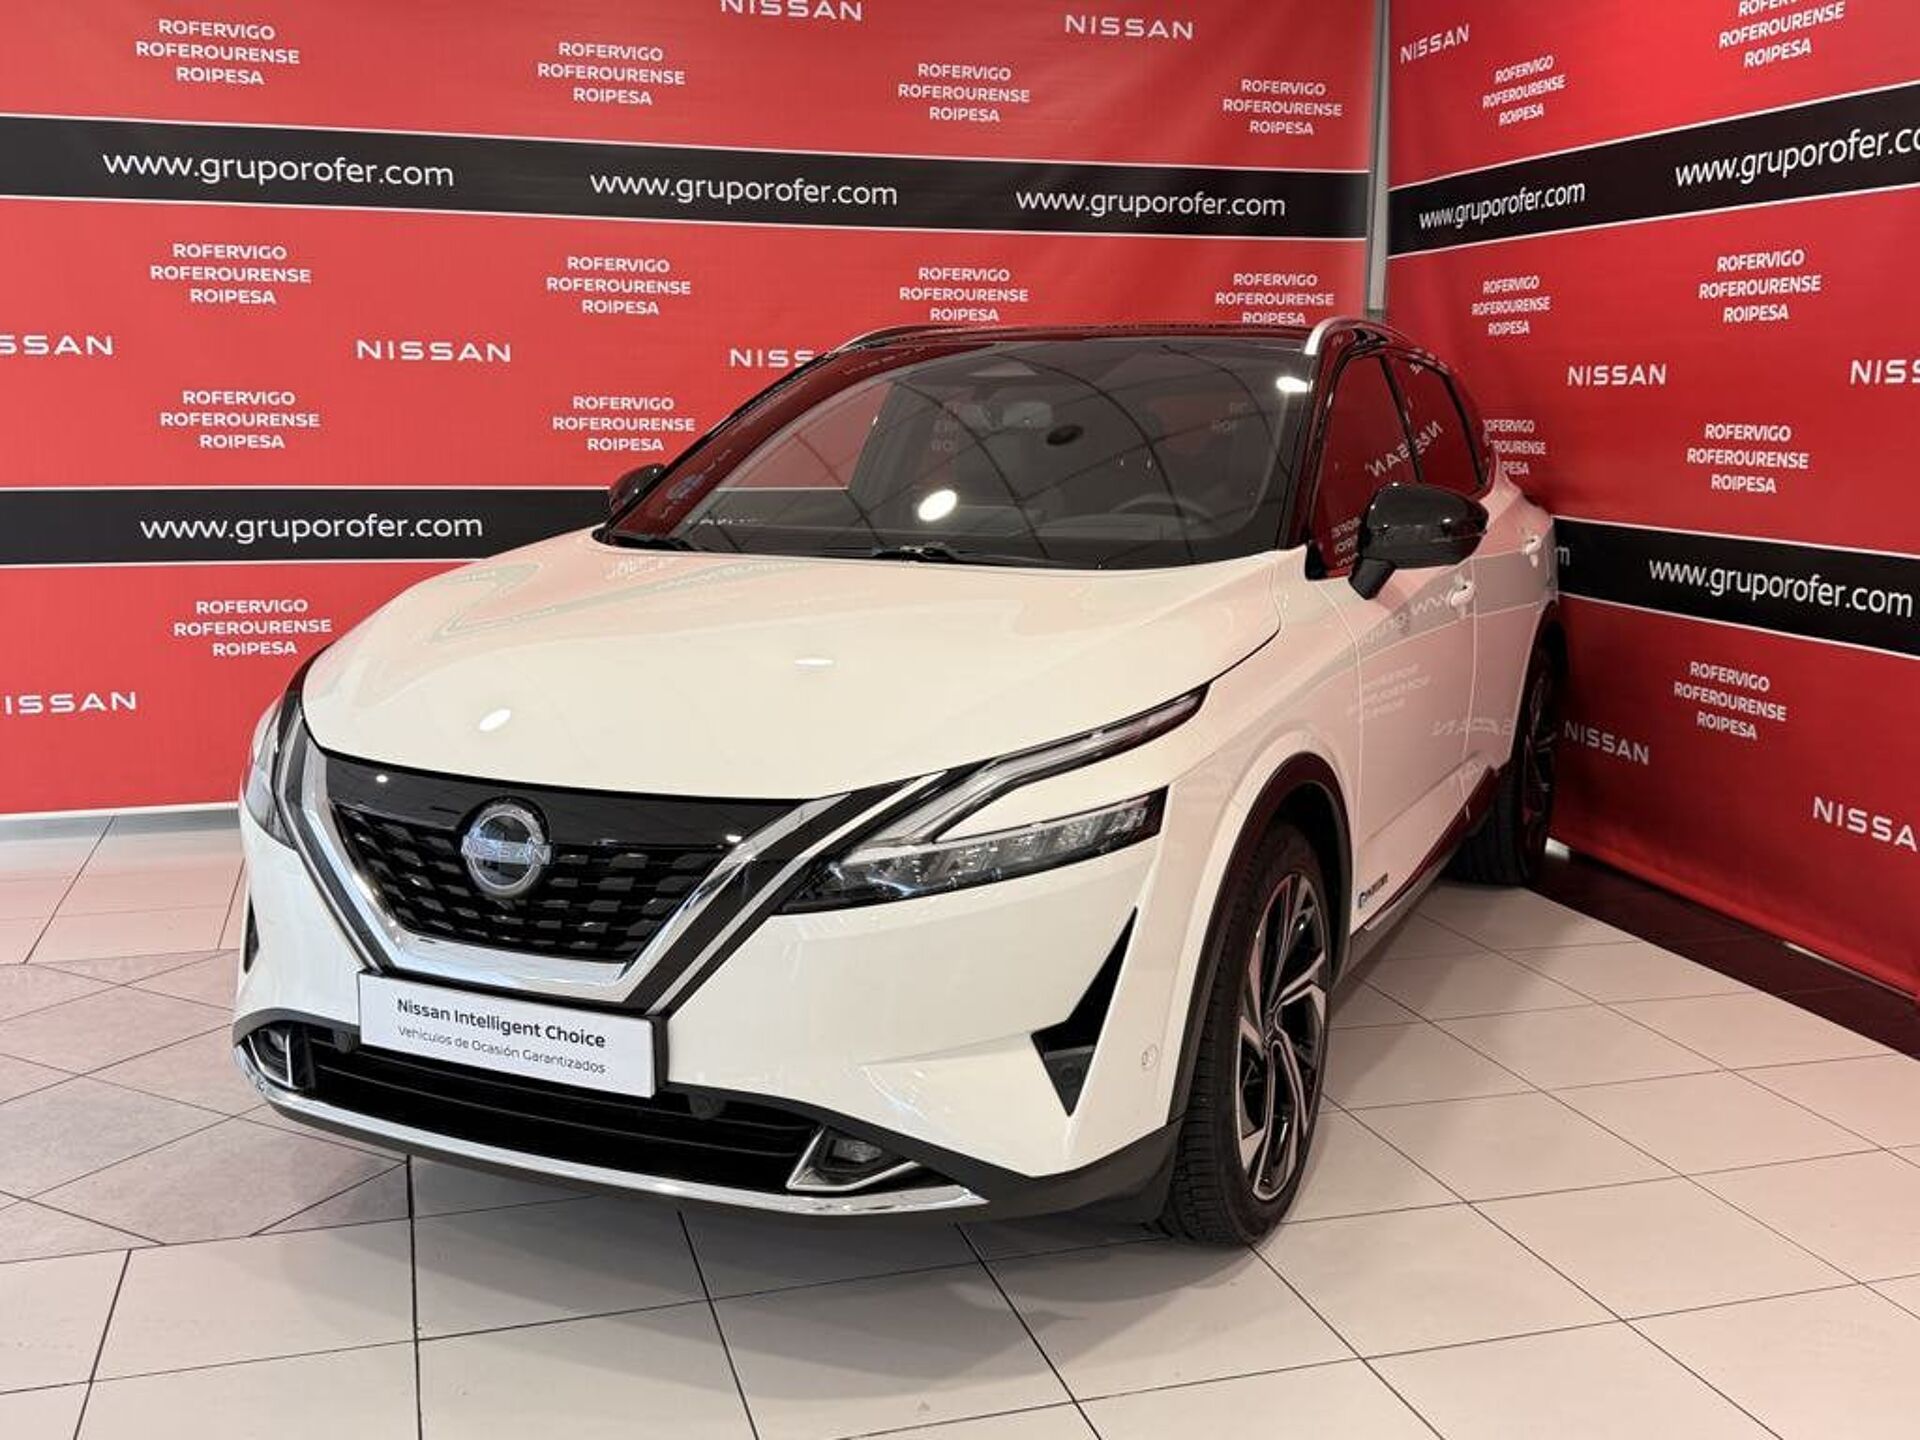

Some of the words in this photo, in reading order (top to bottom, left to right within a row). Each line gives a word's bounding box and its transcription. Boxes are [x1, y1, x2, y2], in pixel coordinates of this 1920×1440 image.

[720, 0, 862, 21] NISSAN
[158, 18, 276, 40] ROFERVIGO
[1065, 14, 1193, 40] NISSAN
[1718, 2, 1846, 49] ROFEROURENSE
[135, 40, 300, 65] ROFEROURENSE
[558, 42, 664, 62] ROFERVIGO
[1400, 24, 1470, 64] NISSAN
[1743, 37, 1812, 68] ROIPESA
[176, 66, 265, 85] ROIPESA
[537, 62, 685, 85] ROFEROURENSE
[918, 62, 1012, 82] ROFERVIGO
[1495, 55, 1553, 85] ROFERVIGO
[573, 87, 653, 106] ROIPESA
[898, 83, 1030, 103] ROFEROURENSE
[1240, 78, 1326, 96] ROFERVIGO
[1482, 75, 1565, 110] ROFEROURENSE
[929, 106, 1001, 123] ROIPESA
[1222, 98, 1343, 117] ROFEROURENSE
[1498, 102, 1544, 126] ROIPESA
[1249, 119, 1314, 136] ROIPESA
[1675, 127, 1920, 187] www.gruporofer.c
[102, 154, 454, 187] www.gruporofer.com
[589, 174, 897, 206] www.gruporofer.com
[1015, 191, 1286, 218] www.gruporofer.com
[1419, 182, 1586, 229] www.gruporofer.com
[172, 243, 288, 260] ROFERVIGO
[1716, 248, 1805, 273] ROFERVIGO
[150, 265, 311, 283] ROFEROURENSE
[567, 255, 670, 273] ROFERVIGO
[918, 267, 1011, 282] ROFERVIGO
[1233, 272, 1318, 287] ROFERVIGO
[1482, 274, 1540, 294] ROFERVIGO
[546, 276, 691, 295] ROFEROURENSE
[899, 286, 1029, 303] ROFEROURENSE
[1698, 274, 1822, 299] ROFEROURENSE
[190, 288, 277, 305] ROIPESA
[1215, 291, 1335, 306] ROFEROURENSE
[1471, 295, 1551, 316] ROFEROURENSE
[581, 299, 660, 315] ROIPESA
[929, 307, 1000, 322] ROIPESA
[1723, 303, 1789, 323] ROIPESA
[1241, 311, 1306, 327] ROIPESA
[1487, 319, 1530, 336] ROIPESA
[0, 334, 113, 356] SSAN
[356, 339, 511, 363] NISSAN
[729, 348, 815, 368] NISS
[1567, 363, 1666, 386] NISSAN
[182, 390, 296, 406] ROFERVIGO
[572, 395, 675, 411] ROFERVIGO
[160, 412, 320, 428] ROFEROURENSE
[552, 416, 695, 432] ROFEROURENSE
[199, 434, 285, 449] ROIPESA
[1704, 423, 1792, 442] ROFERVIGO
[587, 437, 665, 452] ROIPESA
[1686, 447, 1809, 470] ROFEROURENSE
[1711, 473, 1777, 494] ROIPESA
[139, 513, 483, 545] www.gruporofer.com
[1649, 559, 1913, 618] www.gruporofer.com
[195, 599, 308, 615] ROFERVIGO
[173, 618, 332, 637] ROFEROURENSE
[212, 640, 298, 657] ROIPESA
[1690, 661, 1770, 692] ROFERVIGO
[5, 691, 137, 715] ISSAN
[1674, 683, 1786, 722] ROFEROURENSE
[1697, 712, 1757, 740] ROIPESA
[1564, 720, 1650, 766] NISSAN
[1813, 796, 1918, 852] NISSA
[397, 999, 451, 1022] Nissan
[455, 1010, 541, 1036] Intelligent
[545, 1025, 606, 1048] Choice
[455, 1036, 470, 1049] de
[522, 1049, 606, 1074] Garantizados
